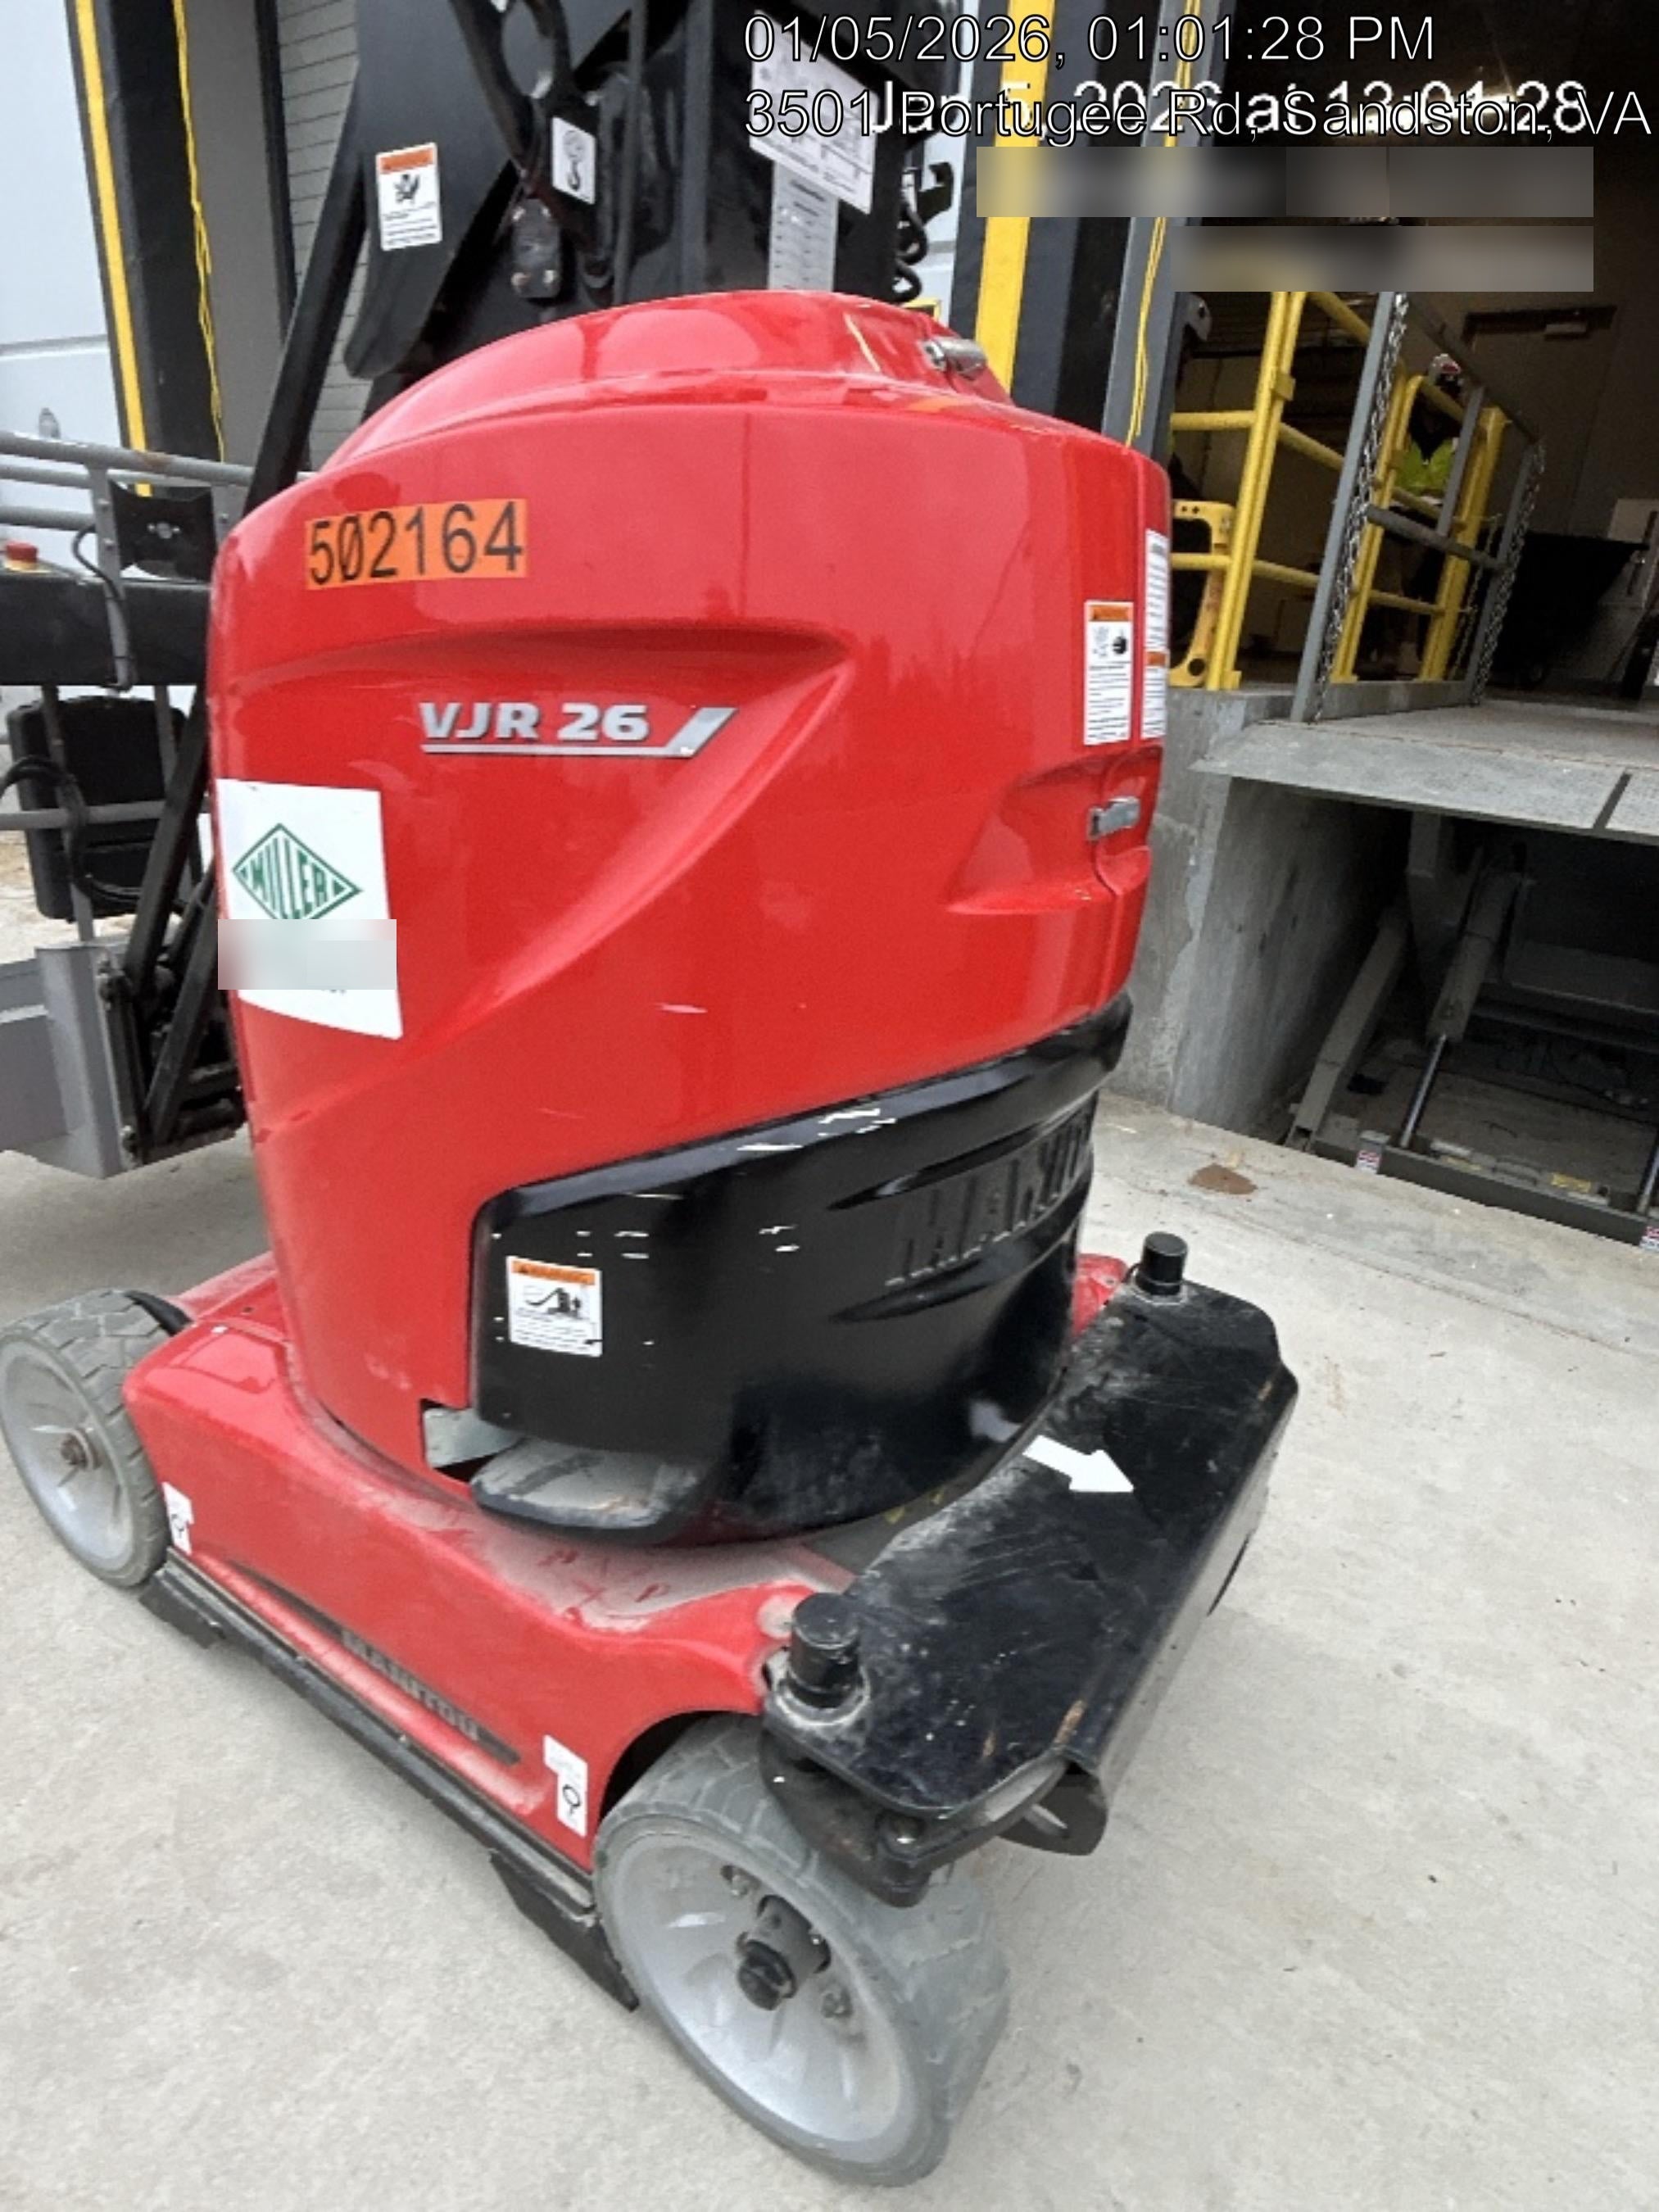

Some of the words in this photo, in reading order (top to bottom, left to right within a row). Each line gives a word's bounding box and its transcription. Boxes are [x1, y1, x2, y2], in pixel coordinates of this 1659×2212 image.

[310, 501, 523, 586] 502164
[419, 701, 542, 741] VJR
[557, 702, 650, 742] 26
[247, 835, 331, 919] MILLER
